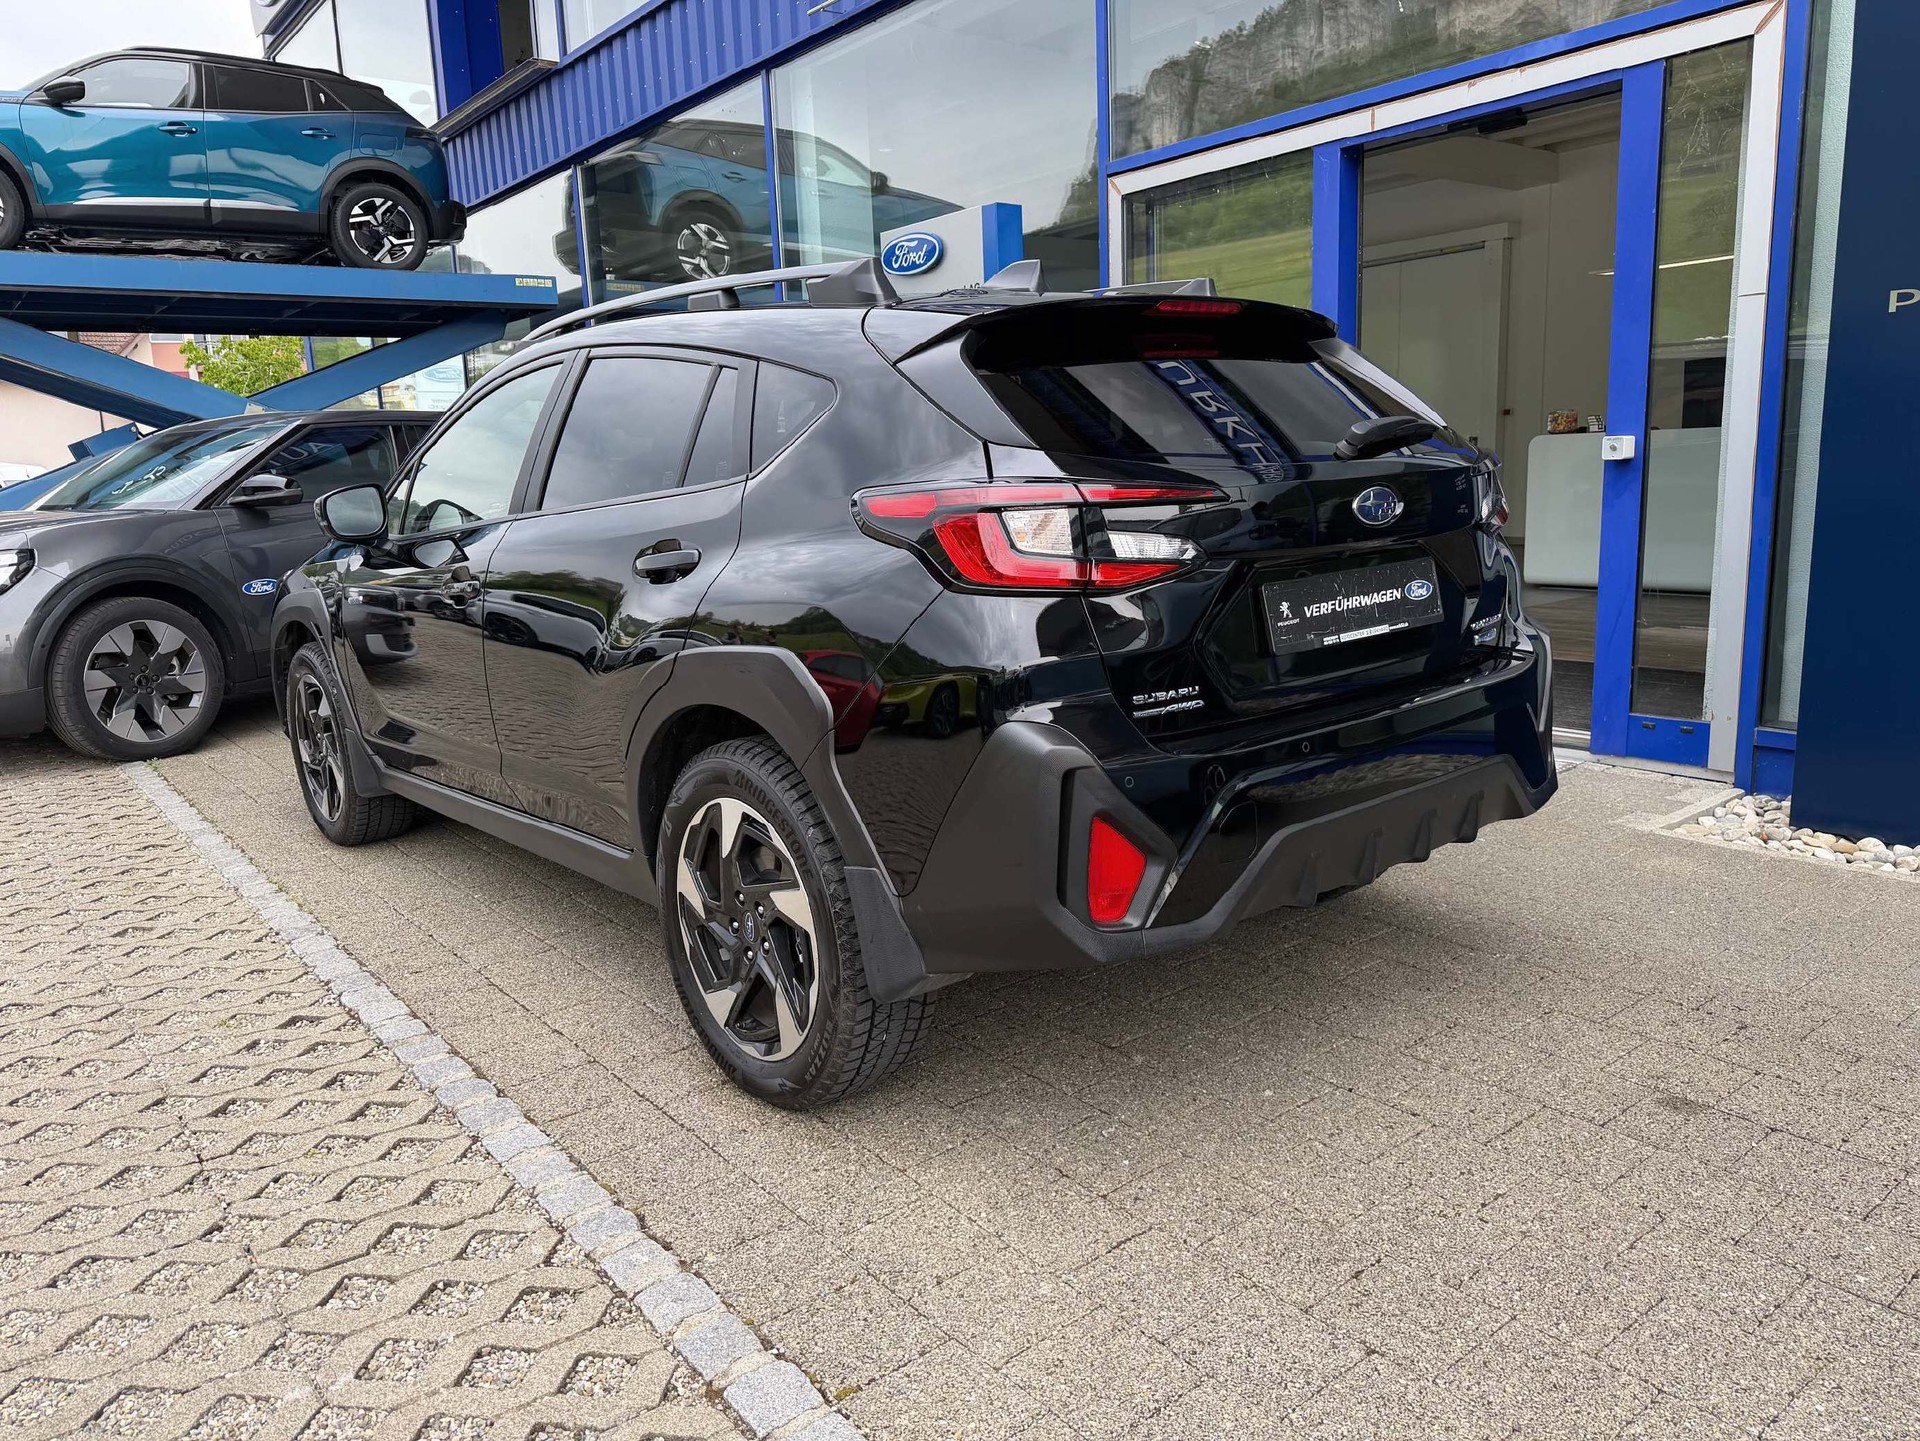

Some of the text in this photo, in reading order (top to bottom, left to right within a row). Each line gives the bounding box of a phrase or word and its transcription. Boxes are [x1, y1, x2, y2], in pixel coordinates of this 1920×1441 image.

[892, 240, 927, 269] Ford
[250, 580, 274, 593] Ford
[1304, 588, 1402, 618] VERFÜHRWAGEN
[1277, 618, 1300, 627] PEUGEOT
[1132, 685, 1200, 705] SUBARU
[1161, 699, 1205, 714] AWD
[733, 768, 815, 882] BRIDGESTONE
